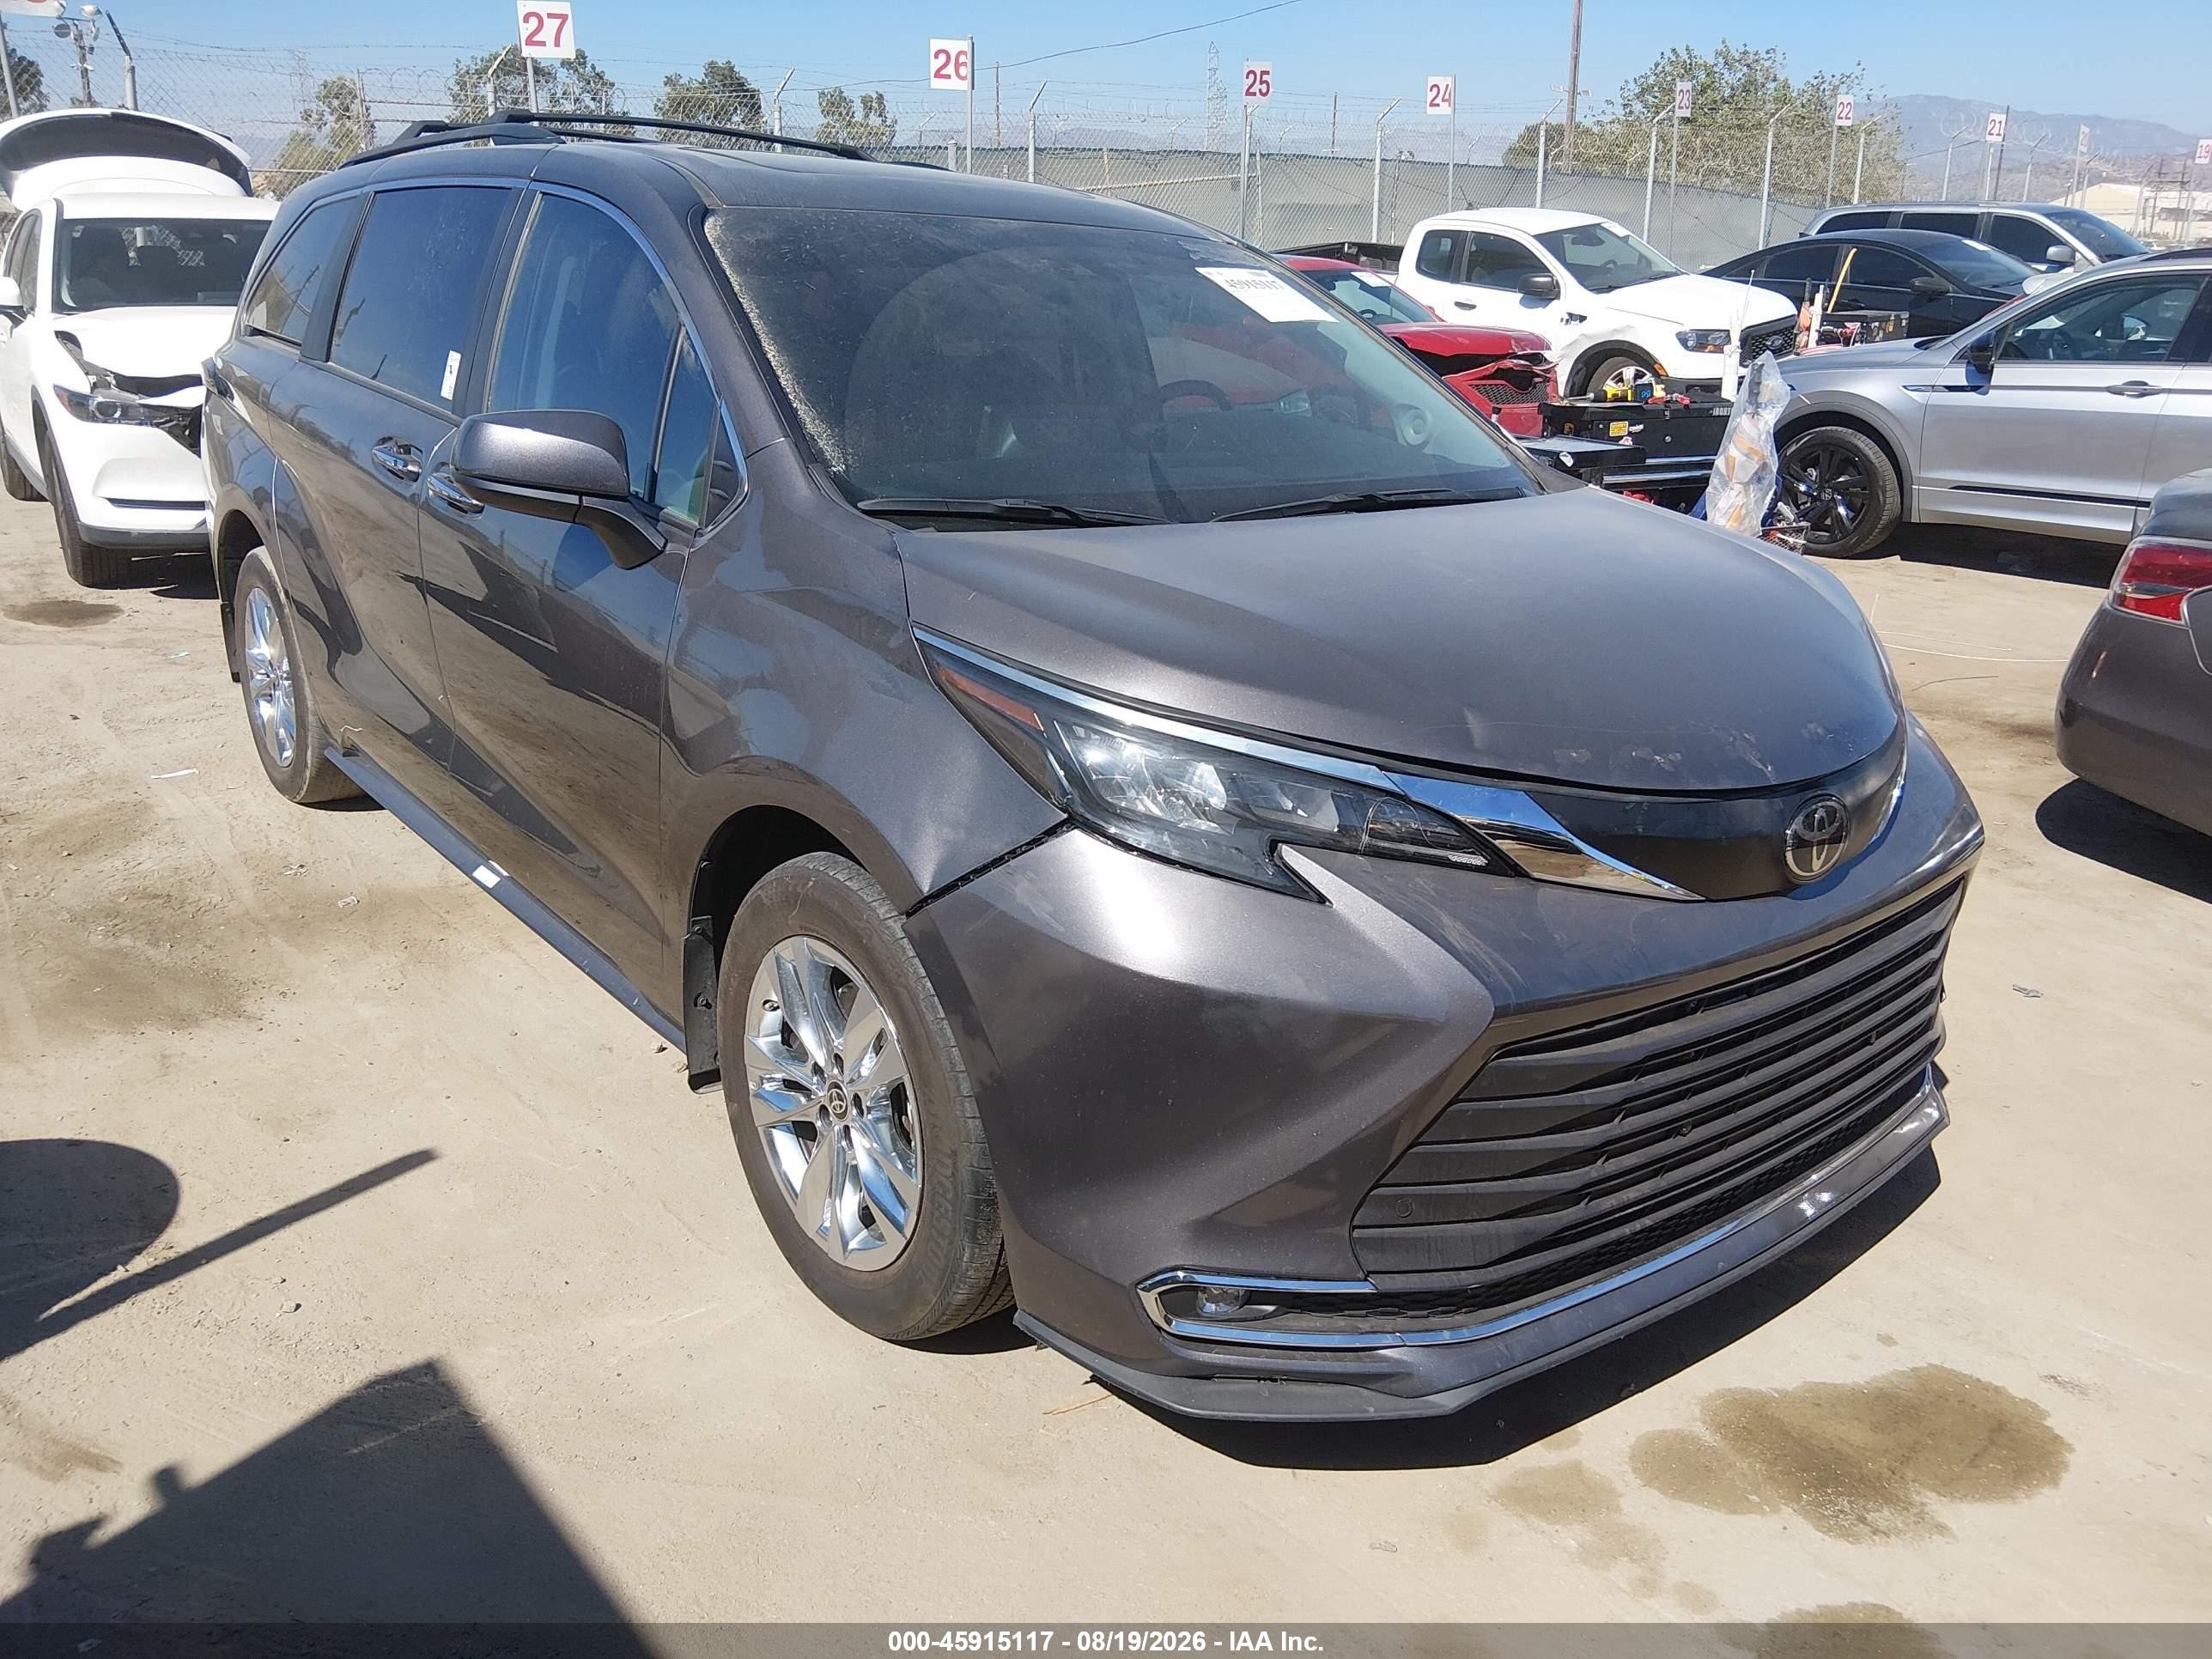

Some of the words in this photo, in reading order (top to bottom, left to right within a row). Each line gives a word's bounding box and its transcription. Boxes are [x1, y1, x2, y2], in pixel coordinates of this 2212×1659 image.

[522, 12, 569, 47] 27
[934, 49, 969, 81] 26
[1245, 70, 1270, 97] 25
[1428, 83, 1451, 107] 24
[1677, 88, 1692, 110] 23
[1837, 101, 1852, 120] 22
[1988, 118, 2002, 137] 21
[2197, 143, 2211, 160] 19
[1224, 279, 1285, 290] 45915117
